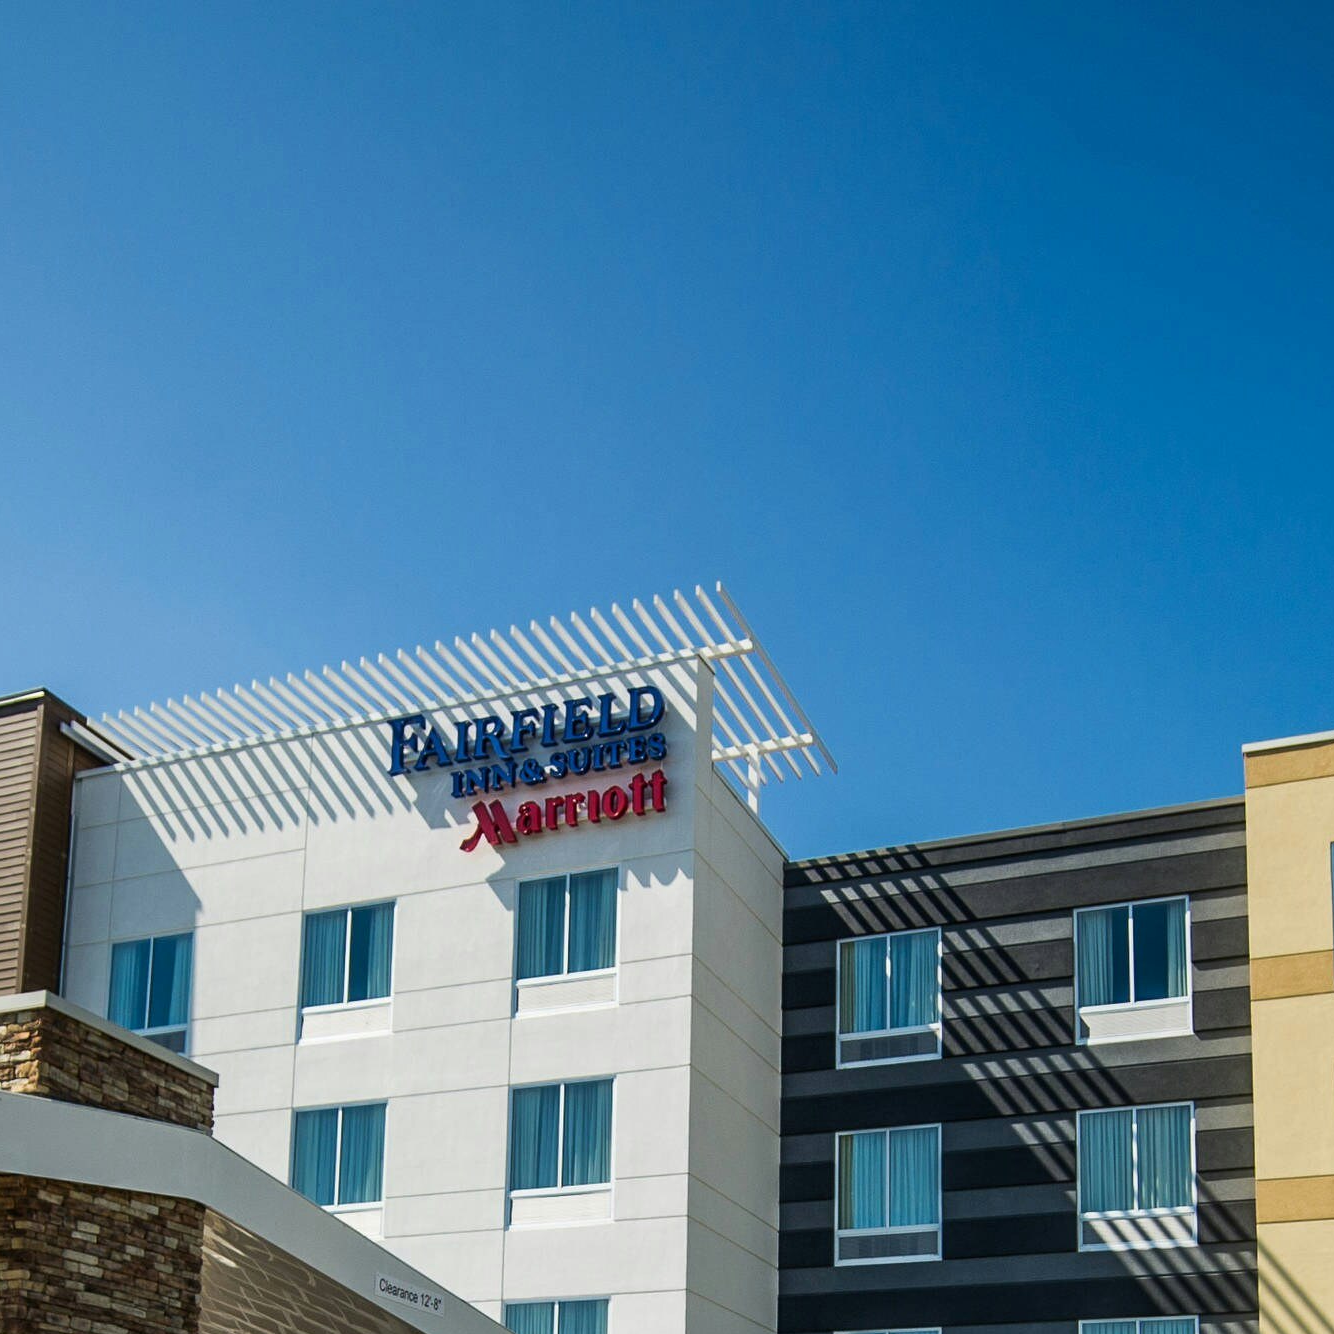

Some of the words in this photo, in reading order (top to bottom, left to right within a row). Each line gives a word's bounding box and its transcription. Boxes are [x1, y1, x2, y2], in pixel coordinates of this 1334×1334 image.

[388, 685, 665, 776] FAIRFIELD
[450, 758, 519, 797] INN
[519, 758, 547, 785] &
[552, 733, 667, 777] SUITES
[459, 769, 667, 852] Marriott
[379, 1278, 419, 1304] Clearance
